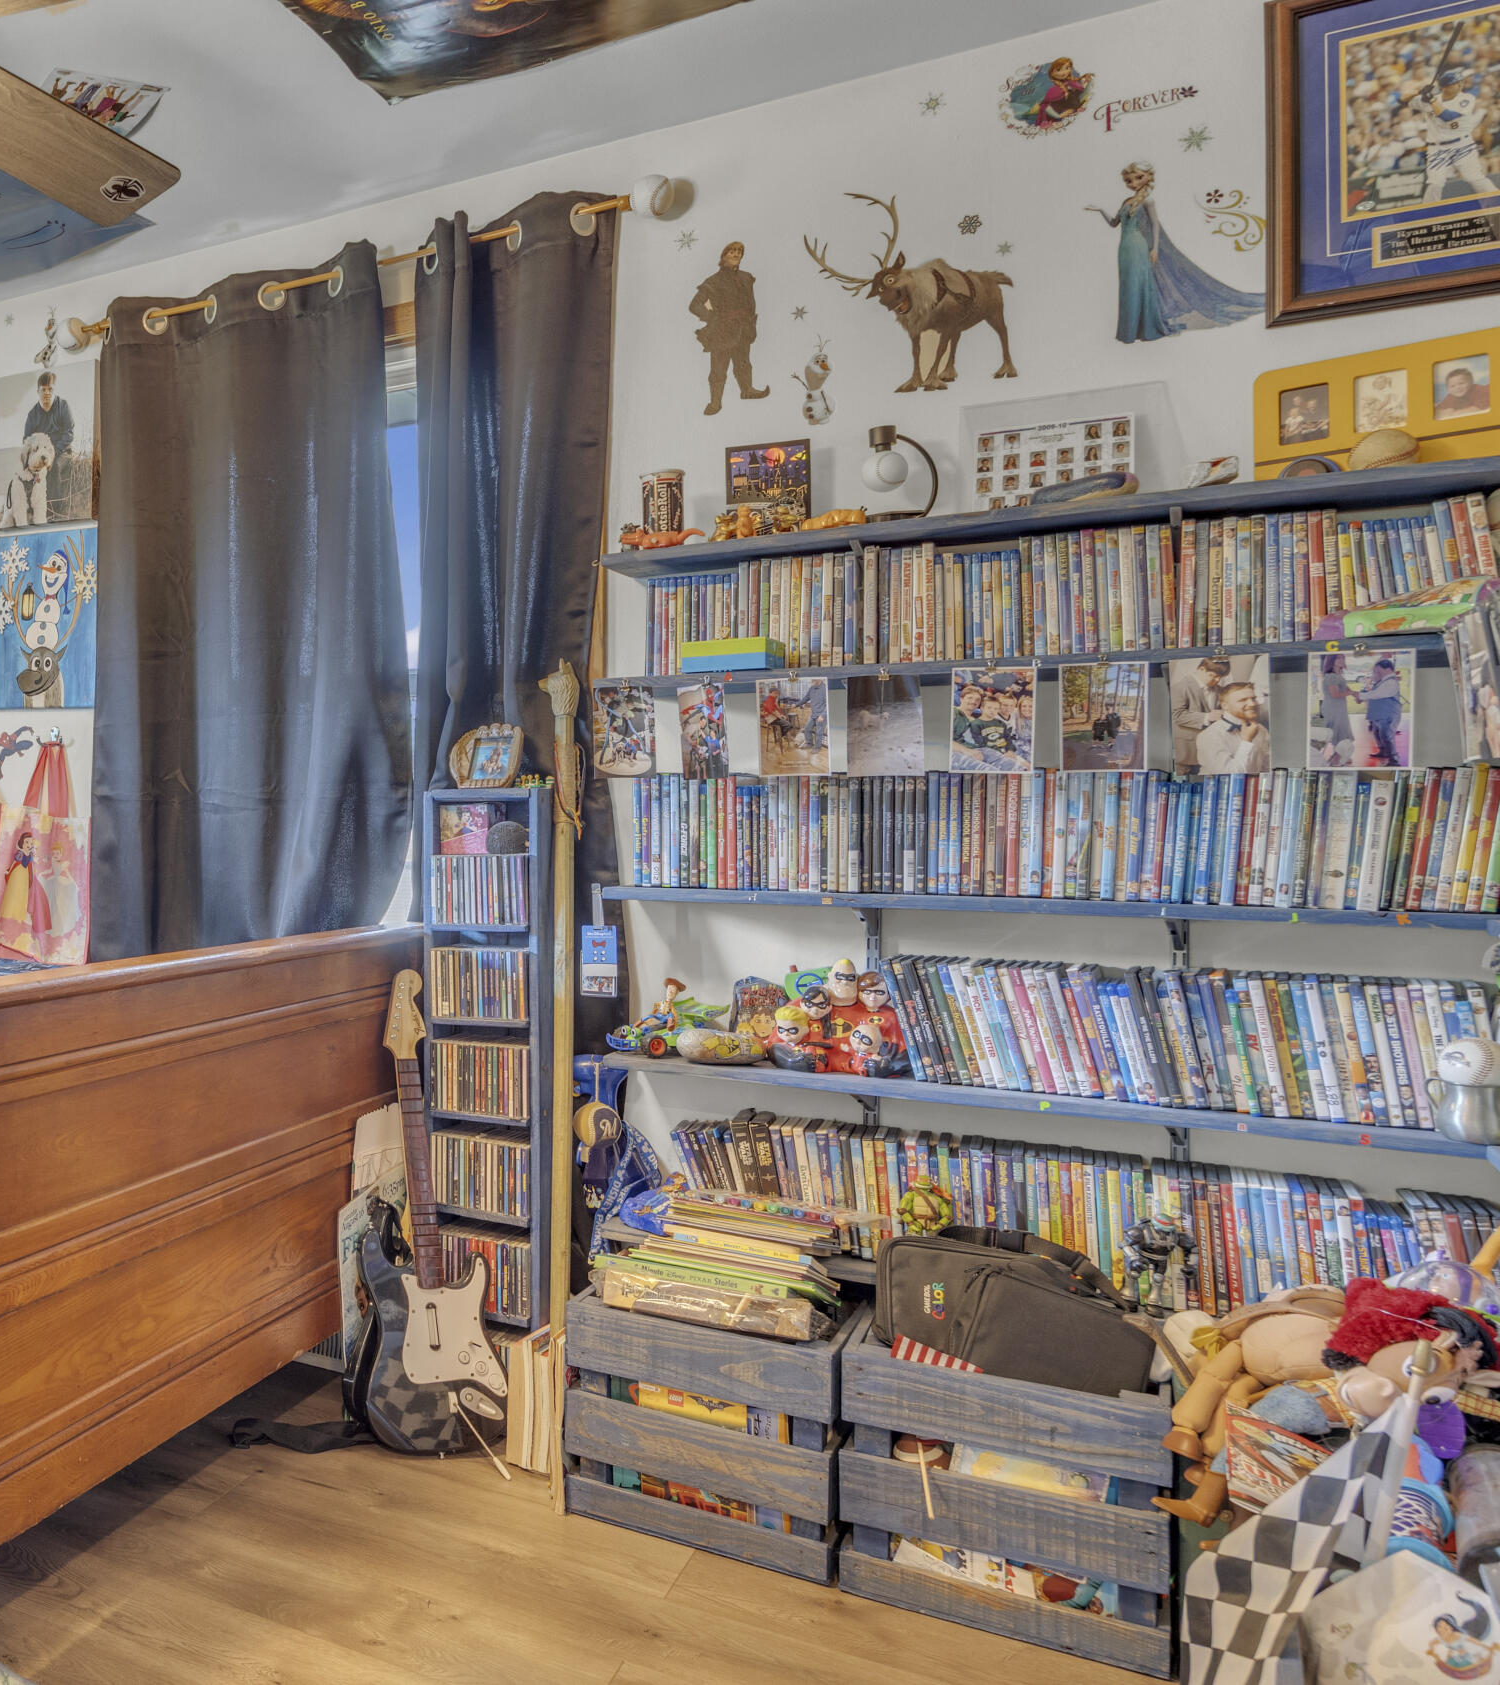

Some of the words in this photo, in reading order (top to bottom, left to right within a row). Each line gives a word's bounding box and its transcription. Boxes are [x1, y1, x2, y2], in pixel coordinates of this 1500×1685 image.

[1093, 87, 1181, 132] FOREVER
[1267, 545, 1277, 580] BEDTIME
[1477, 534, 1493, 569] CHEAPER
[903, 562, 912, 588] ALVIN
[925, 558, 934, 584] ALVIN
[1310, 562, 1324, 577] BOLT
[1211, 576, 1220, 608] Benny
[1225, 589, 1233, 619] HOLIDAY
[812, 606, 820, 629] Andre
[881, 595, 890, 634] AVATAR
[925, 593, 934, 643] CHIPMUNKS
[1211, 609, 1220, 626] Hill
[1325, 640, 1339, 652] C
[973, 789, 981, 808] HIGH
[1010, 779, 1019, 821] HANGOVER
[1022, 797, 1031, 820] HOTEL
[963, 812, 971, 836] SCHOOL
[973, 809, 981, 832] SCHOOL
[1021, 827, 1031, 848] DOGS
[1176, 835, 1185, 852] CAT
[1198, 840, 1208, 871] MELTDOWN
[1173, 860, 1184, 878] HAT
[978, 977, 990, 1001] POPEYE
[972, 995, 982, 1013] PICK
[984, 1036, 996, 1058] LITTER
[1023, 1009, 1033, 1027] PINK
[1092, 1004, 1111, 1049] RATATOUILLE
[1372, 1011, 1381, 1024] JAM
[1386, 1015, 1400, 1039] STEP
[1027, 1027, 1040, 1052] PANTHER
[1182, 1034, 1197, 1067] CONCERT
[1246, 1034, 1260, 1051] RV
[1255, 1005, 1270, 1039] Ramona
[1263, 1045, 1277, 1073] Beezus
[1146, 1042, 1158, 1064] MILLERS
[1392, 1040, 1409, 1085] BROTHERS
[599, 1117, 618, 1137] M
[1358, 1133, 1371, 1145] S
[1084, 1177, 1092, 1192] FILM
[1085, 1193, 1093, 1224] FAVORITES
[1212, 1209, 1224, 1281] SPIDER-MAN
[1225, 1211, 1240, 1289] SPIDER-MAN
[1296, 1225, 1307, 1252] STUART
[1314, 1229, 1325, 1256] SCOTT
[1199, 1219, 1211, 1297] SPIDER-MAN
[1358, 1247, 1369, 1274] STUART
[641, 1264, 663, 1277] Minute
[688, 1274, 713, 1286] PIXAR
[713, 1277, 739, 1290] Stories
[1217, 1281, 1226, 1294] 3
[923, 1285, 931, 1298] BOY
[932, 1281, 945, 1320] COLOR
[923, 1298, 931, 1314] GAME
[668, 1392, 684, 1405] LEGO
[696, 1398, 724, 1410] BATMAN
